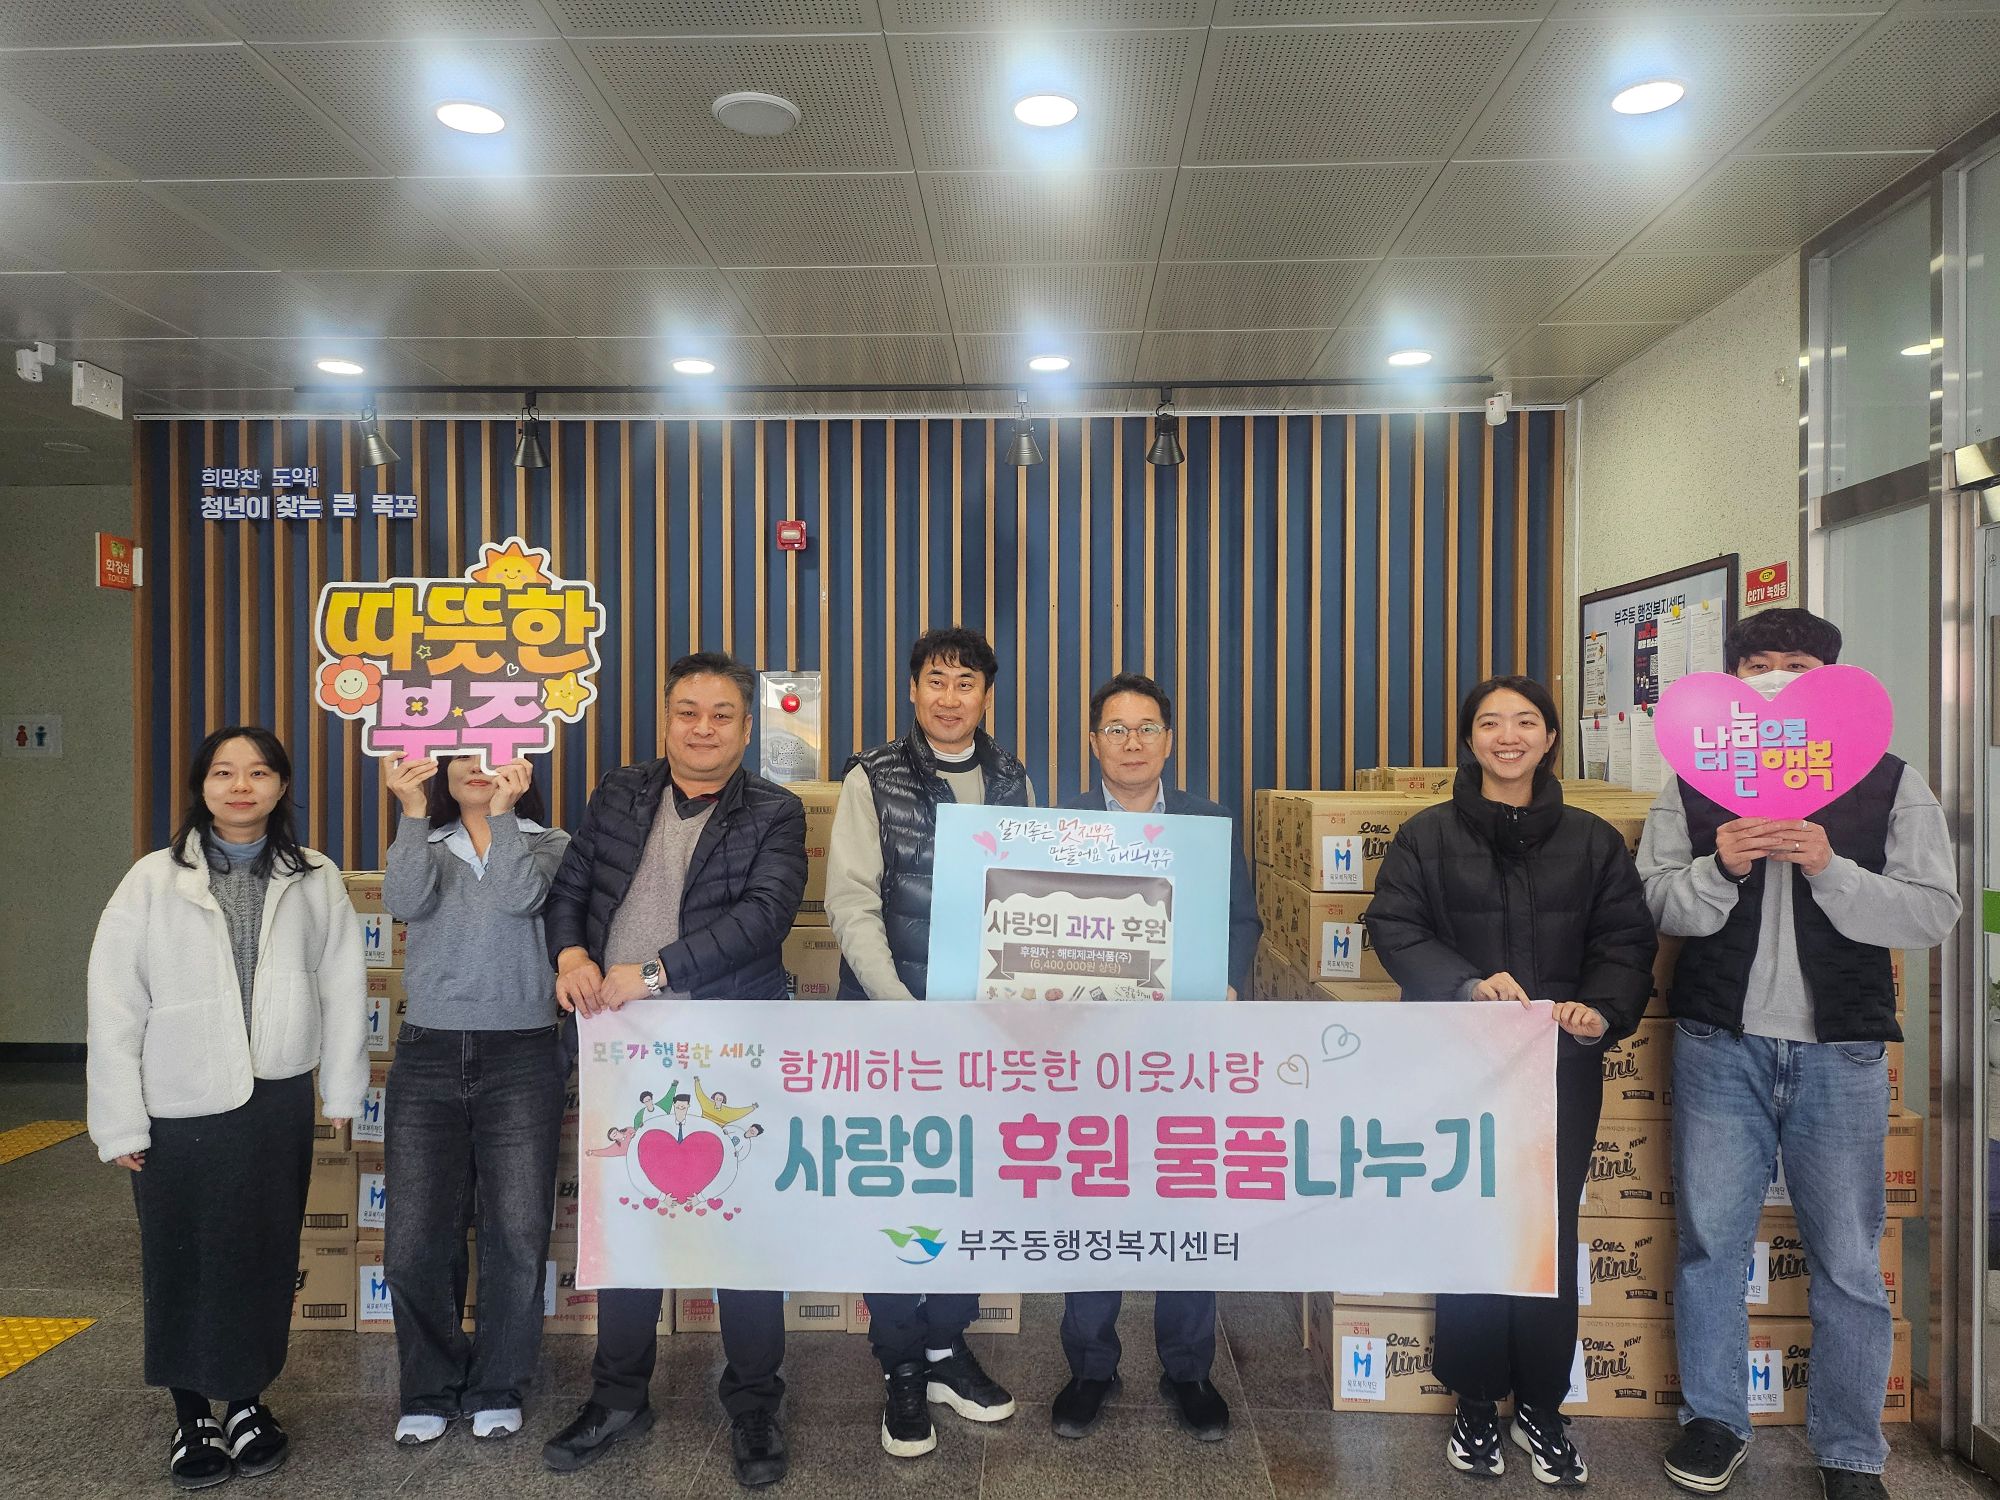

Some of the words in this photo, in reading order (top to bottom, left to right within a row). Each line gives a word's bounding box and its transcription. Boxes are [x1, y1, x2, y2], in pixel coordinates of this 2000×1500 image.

[201, 467, 260, 489] 희망찬
[272, 467, 319, 488] 도약!
[201, 495, 270, 520] 청년이
[275, 495, 323, 520] 찾는
[332, 493, 357, 518] 큰
[371, 494, 419, 519] 목포
[105, 558, 131, 577] 화장실
[107, 573, 129, 584] TOILET
[1746, 588, 1766, 604] CCTV
[1766, 581, 1788, 599] 녹화중
[1614, 605, 1636, 627] 부주동
[1637, 594, 1686, 623] 행정복지센터
[325, 587, 596, 676] 따뜻한
[372, 679, 545, 766] 부주
[1693, 701, 1807, 749] 나눔으로
[1695, 751, 1729, 771] 더
[1734, 750, 1758, 798] 큰
[1761, 740, 1833, 791] 행복
[999, 817, 1055, 841] 살기좋은
[1358, 821, 1391, 834] 오예스
[1049, 845, 1102, 867] 만들어요
[987, 910, 1058, 938] 사랑의
[1065, 915, 1115, 941] 과자
[1121, 916, 1167, 944] 후원
[1020, 946, 1050, 958] 후원자
[1057, 948, 1132, 964] 해태제과식품(주)
[1030, 958, 1095, 973] (6,400,000원
[1097, 960, 1122, 975] 상당)
[801, 983, 830, 993] (3번들)
[1631, 1037, 1650, 1049] NEW!
[593, 1041, 649, 1065] 모두가
[652, 1041, 713, 1069] 행복한
[719, 1042, 765, 1069] 세상
[779, 1048, 944, 1093] 함께하는
[959, 1049, 1081, 1093] 따뜻한
[1096, 1050, 1265, 1094] 이웃사랑
[1603, 1052, 1638, 1081] ini
[1629, 1136, 1648, 1149] NEW!
[774, 1113, 974, 1199] 사랑의
[998, 1112, 1131, 1199] 후원
[1886, 1170, 1917, 1184] 2개입
[957, 1228, 1241, 1263] 부주동행정복지센터
[1589, 1238, 1626, 1252] 오예스
[1634, 1236, 1653, 1249] NEW!
[1768, 1253, 1811, 1281] Min
[1386, 1333, 1420, 1347] 오예스
[1582, 1337, 1615, 1351] 오예스
[1624, 1335, 1642, 1348] NEW!
